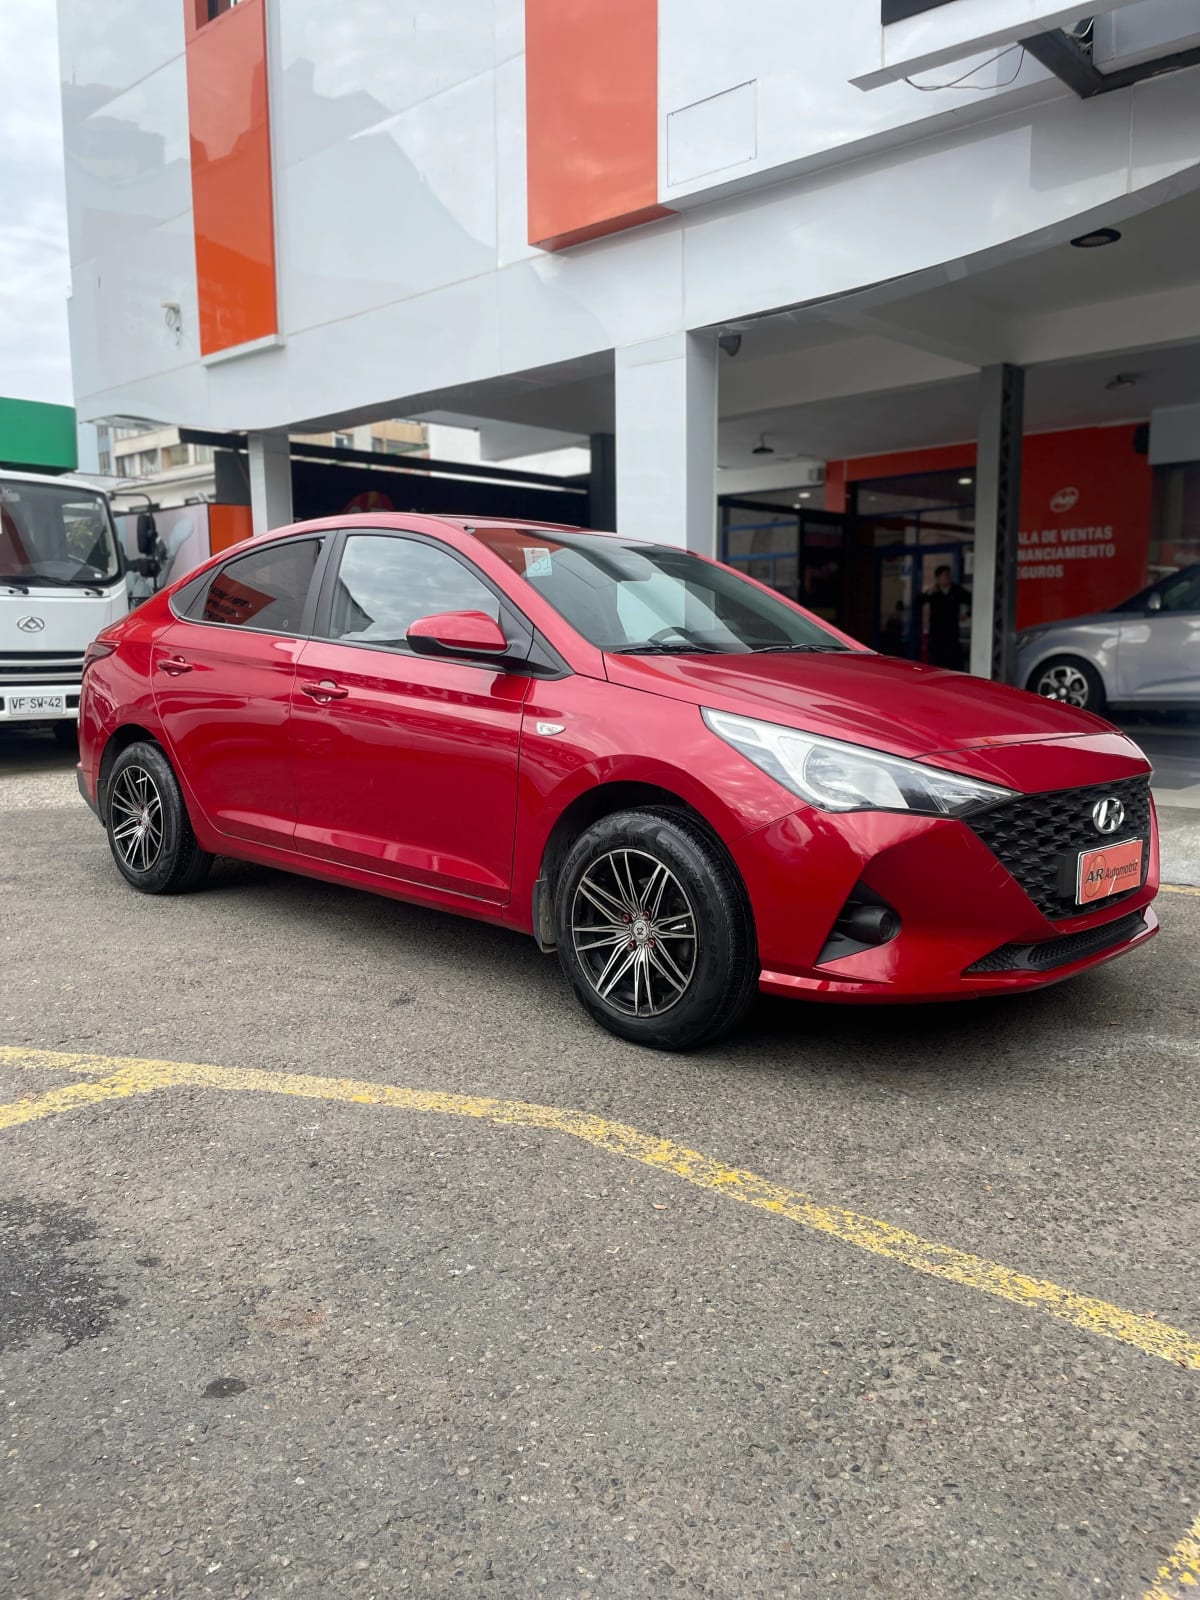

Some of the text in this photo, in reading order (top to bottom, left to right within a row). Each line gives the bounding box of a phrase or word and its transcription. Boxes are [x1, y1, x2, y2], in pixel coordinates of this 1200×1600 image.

[1017, 526, 1113, 545] ALA DE VENTAS
[1017, 544, 1115, 561] NANCIAMIENTO
[1105, 862, 1138, 880] Automotriz
